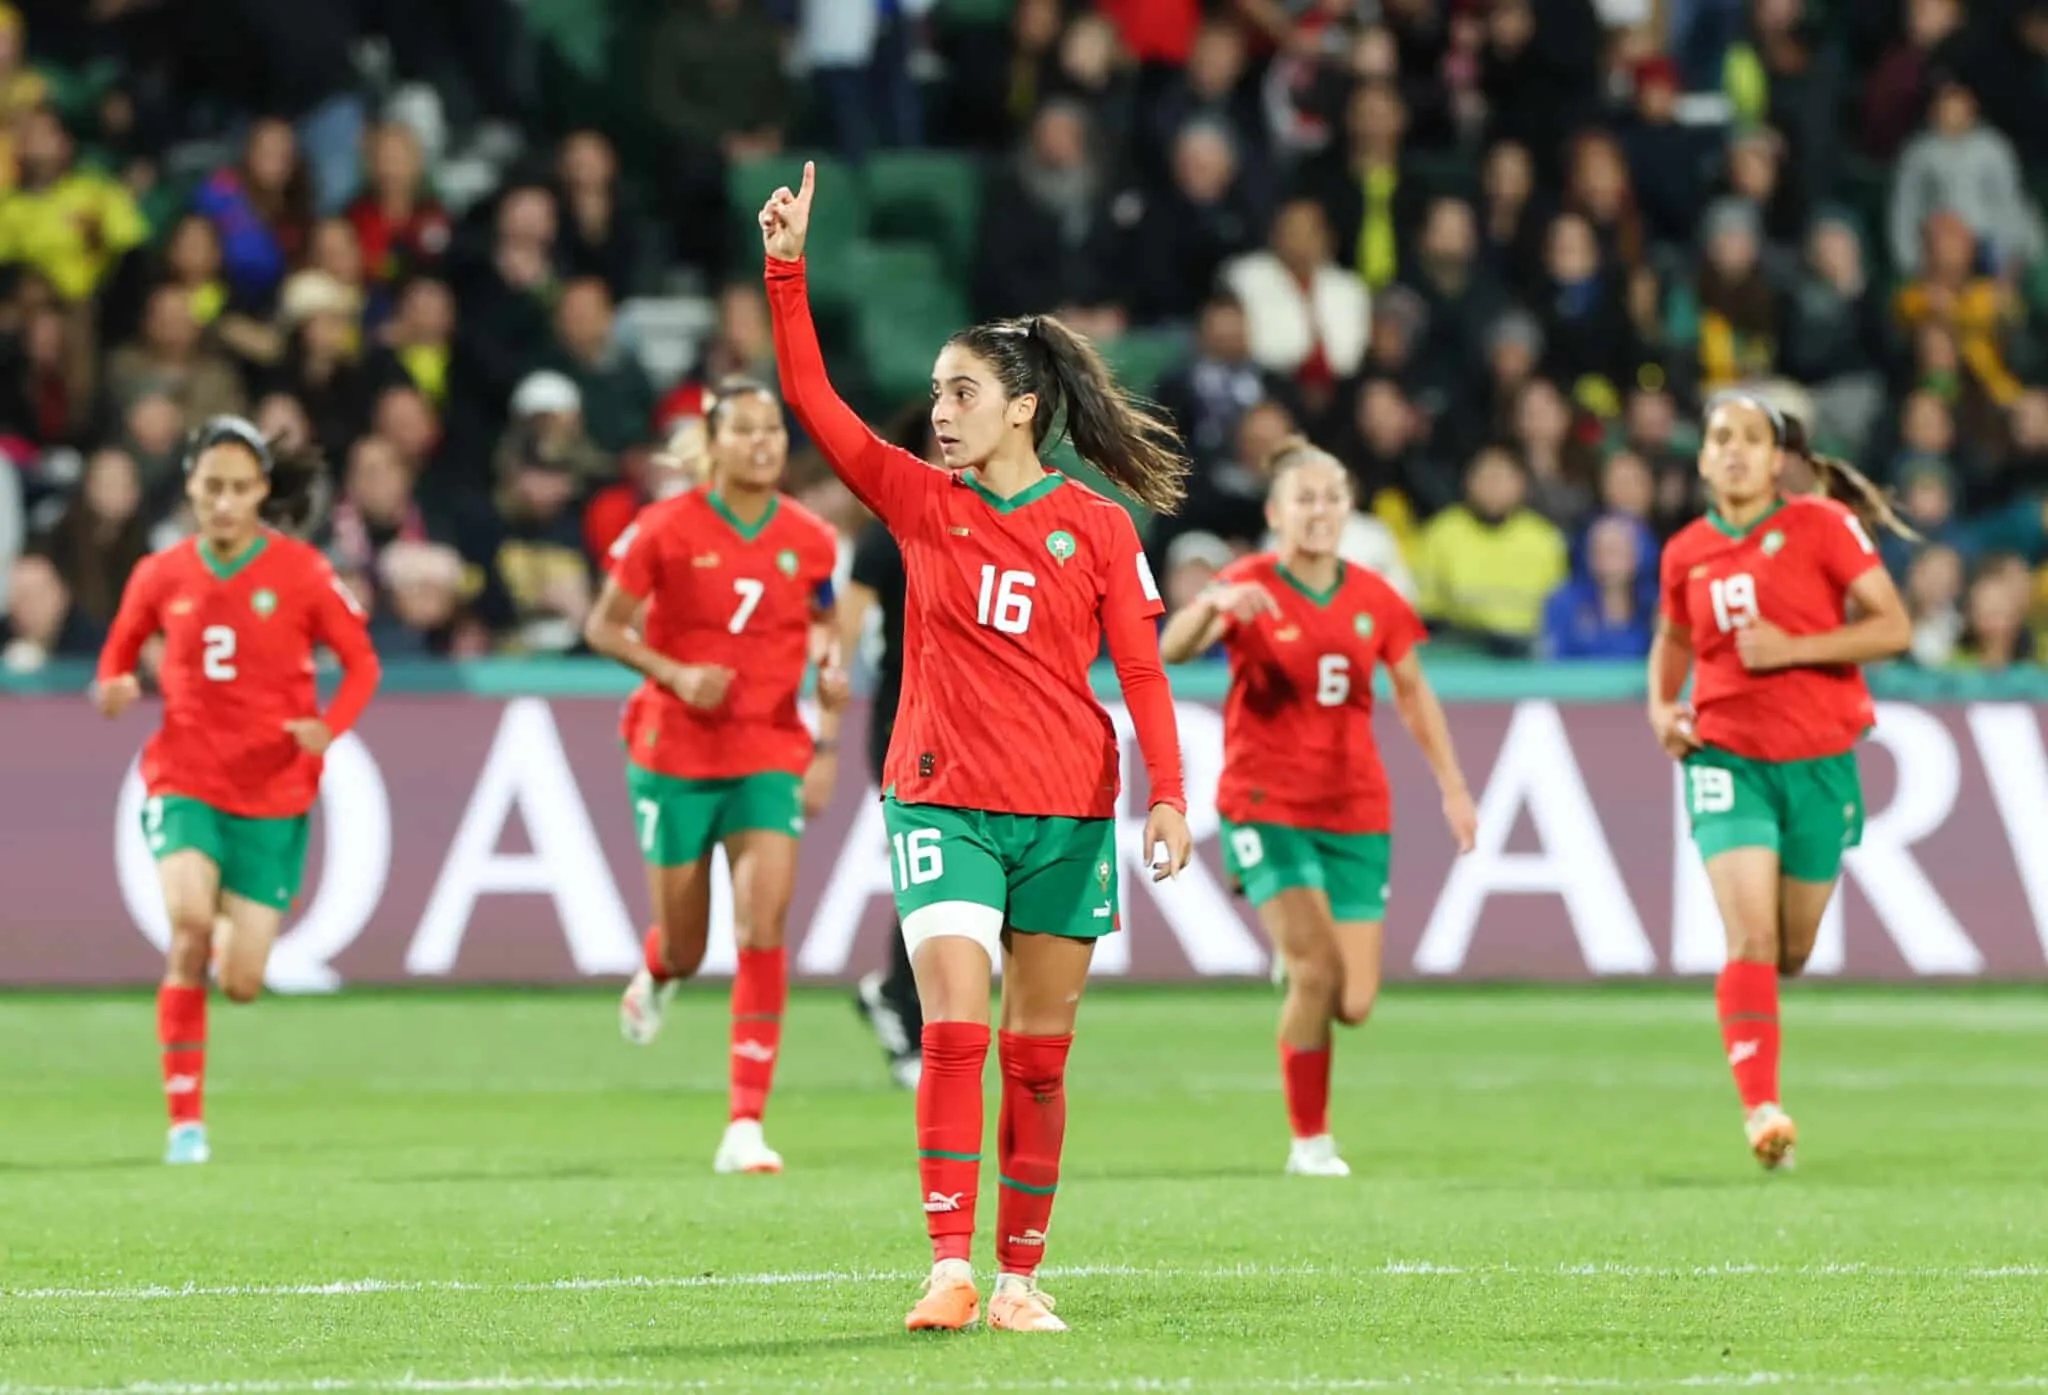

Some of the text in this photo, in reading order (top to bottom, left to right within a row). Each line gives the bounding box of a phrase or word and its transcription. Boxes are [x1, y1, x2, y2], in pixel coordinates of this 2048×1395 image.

[728, 576, 765, 635] 7
[977, 563, 1037, 635] 16
[1709, 572, 1758, 633] 19
[202, 624, 238, 682] 2
[1316, 653, 1350, 707] 6
[114, 697, 2048, 994] QAR AR
[636, 797, 660, 852] 7
[892, 827, 945, 893] 16
